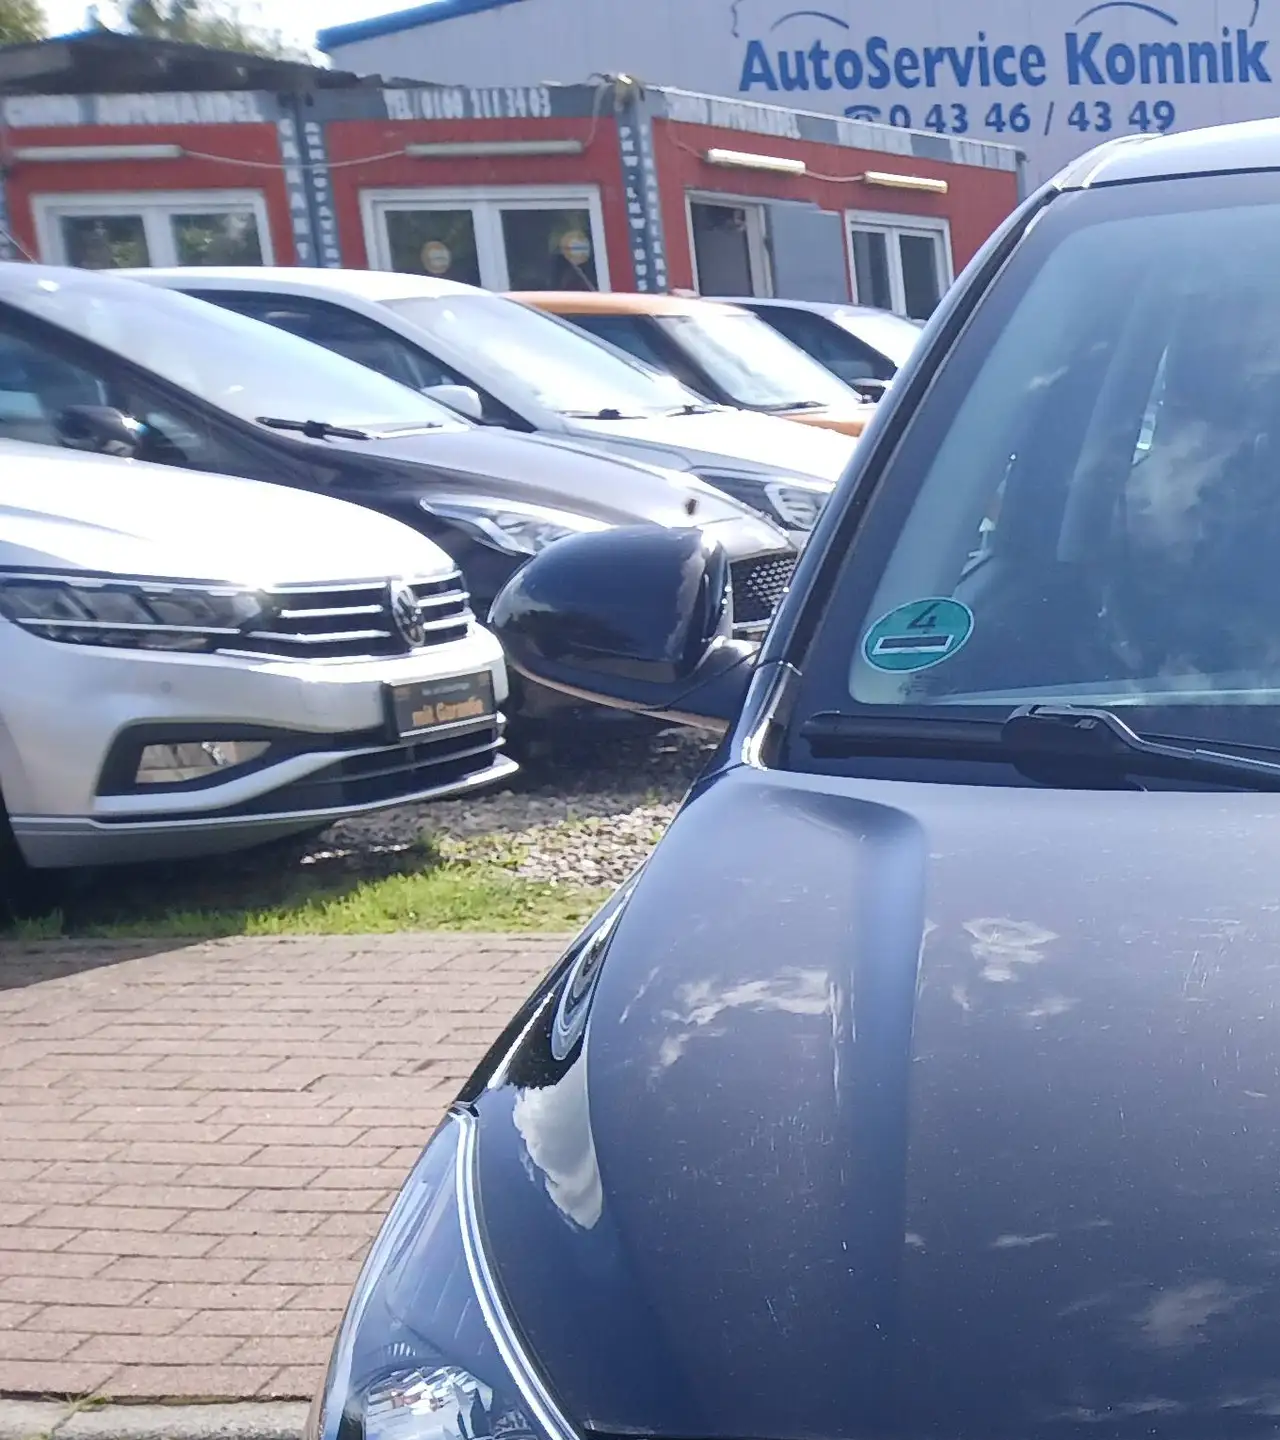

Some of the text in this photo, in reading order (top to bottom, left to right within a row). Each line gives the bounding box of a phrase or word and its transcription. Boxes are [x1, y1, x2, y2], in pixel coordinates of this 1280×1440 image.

[739, 27, 1272, 92] AutoService Komnik
[924, 103, 969, 134] 43
[984, 102, 1032, 132] 46
[1044, 102, 1055, 136] /
[1067, 100, 1112, 132] 43
[1128, 100, 1176, 135] 49
